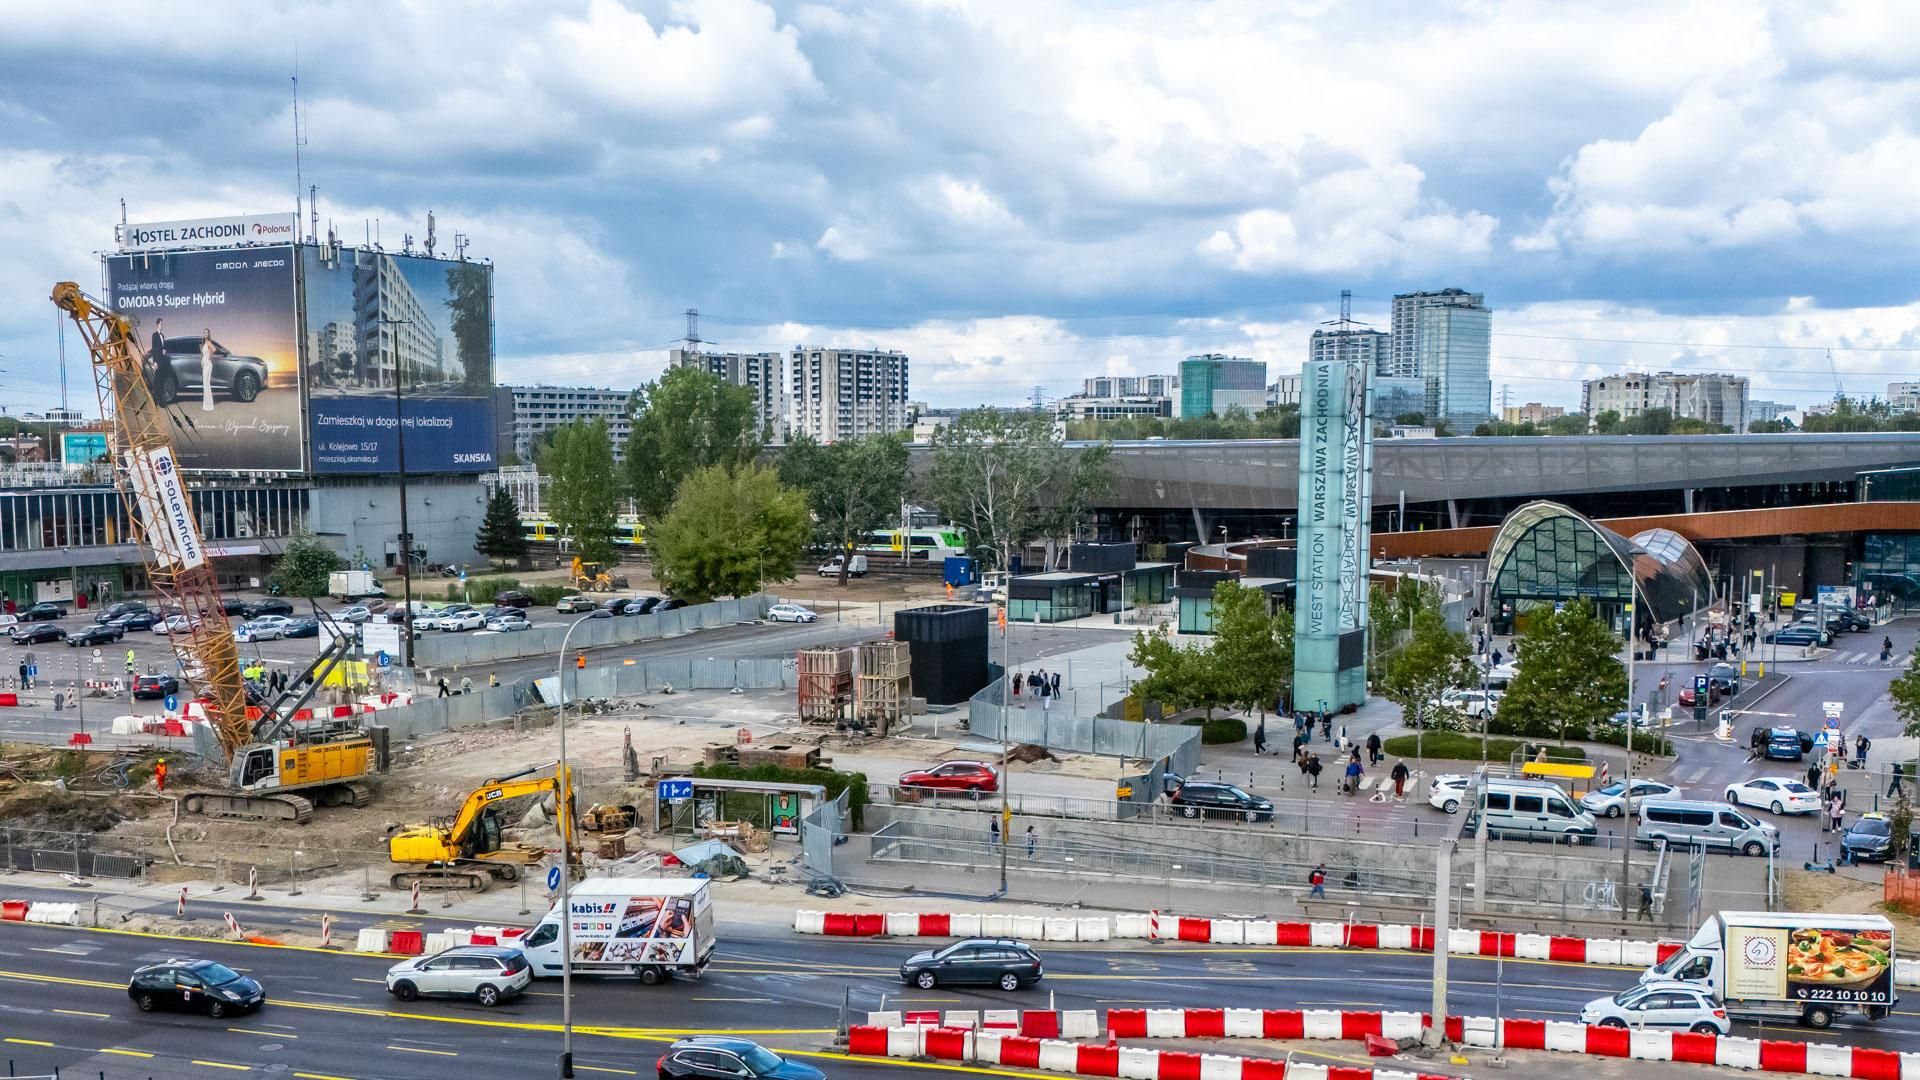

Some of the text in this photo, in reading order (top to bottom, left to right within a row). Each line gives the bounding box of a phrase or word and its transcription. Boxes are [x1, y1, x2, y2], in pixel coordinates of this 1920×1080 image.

[127, 223, 245, 246] HOSTEL ZACHODNI
[262, 224, 291, 234] Polonus
[118, 291, 225, 309] OMODA 9 Super Hybrid
[317, 413, 365, 428] Zamieszkaj
[366, 417, 374, 426] w
[416, 415, 453, 429] lokalizacji
[318, 442, 378, 452] ul. Kolejowa 15/17
[454, 453, 492, 464] SKANSKA
[1311, 364, 1329, 633] WEST STATION WARSZAWA ZACHODNIA
[1697, 677, 1706, 688] P
[486, 790, 502, 800] JCB
[571, 902, 603, 914] kabis
[1811, 989, 1886, 1002] 222 10 10 10
